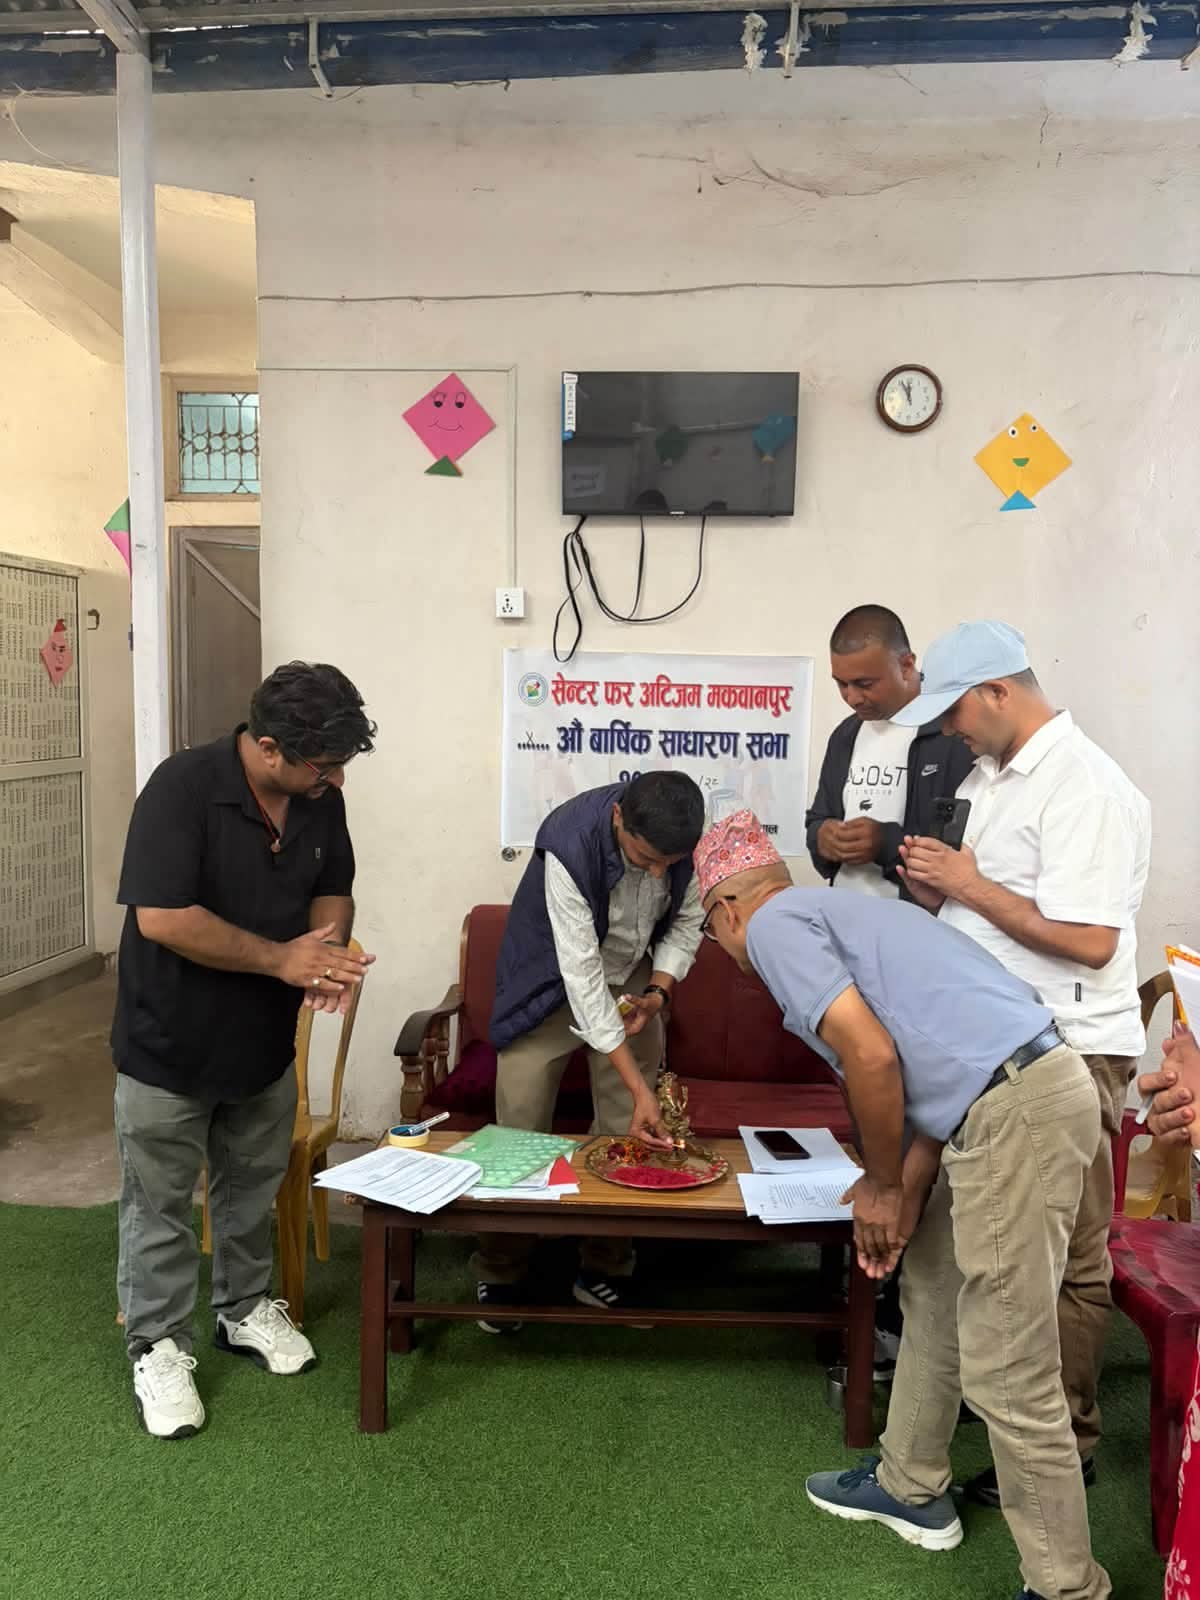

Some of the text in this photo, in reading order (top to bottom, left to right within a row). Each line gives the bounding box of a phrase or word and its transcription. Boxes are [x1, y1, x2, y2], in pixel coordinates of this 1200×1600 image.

[551, 672, 600, 707] सेन्टर
[603, 681, 635, 708] फर
[639, 674, 703, 709] अटिजम
[707, 684, 793, 718] मकवानपुर
[556, 717, 791, 761] औ बार्षिक साधारण सभा
[847, 765, 908, 787] COST
